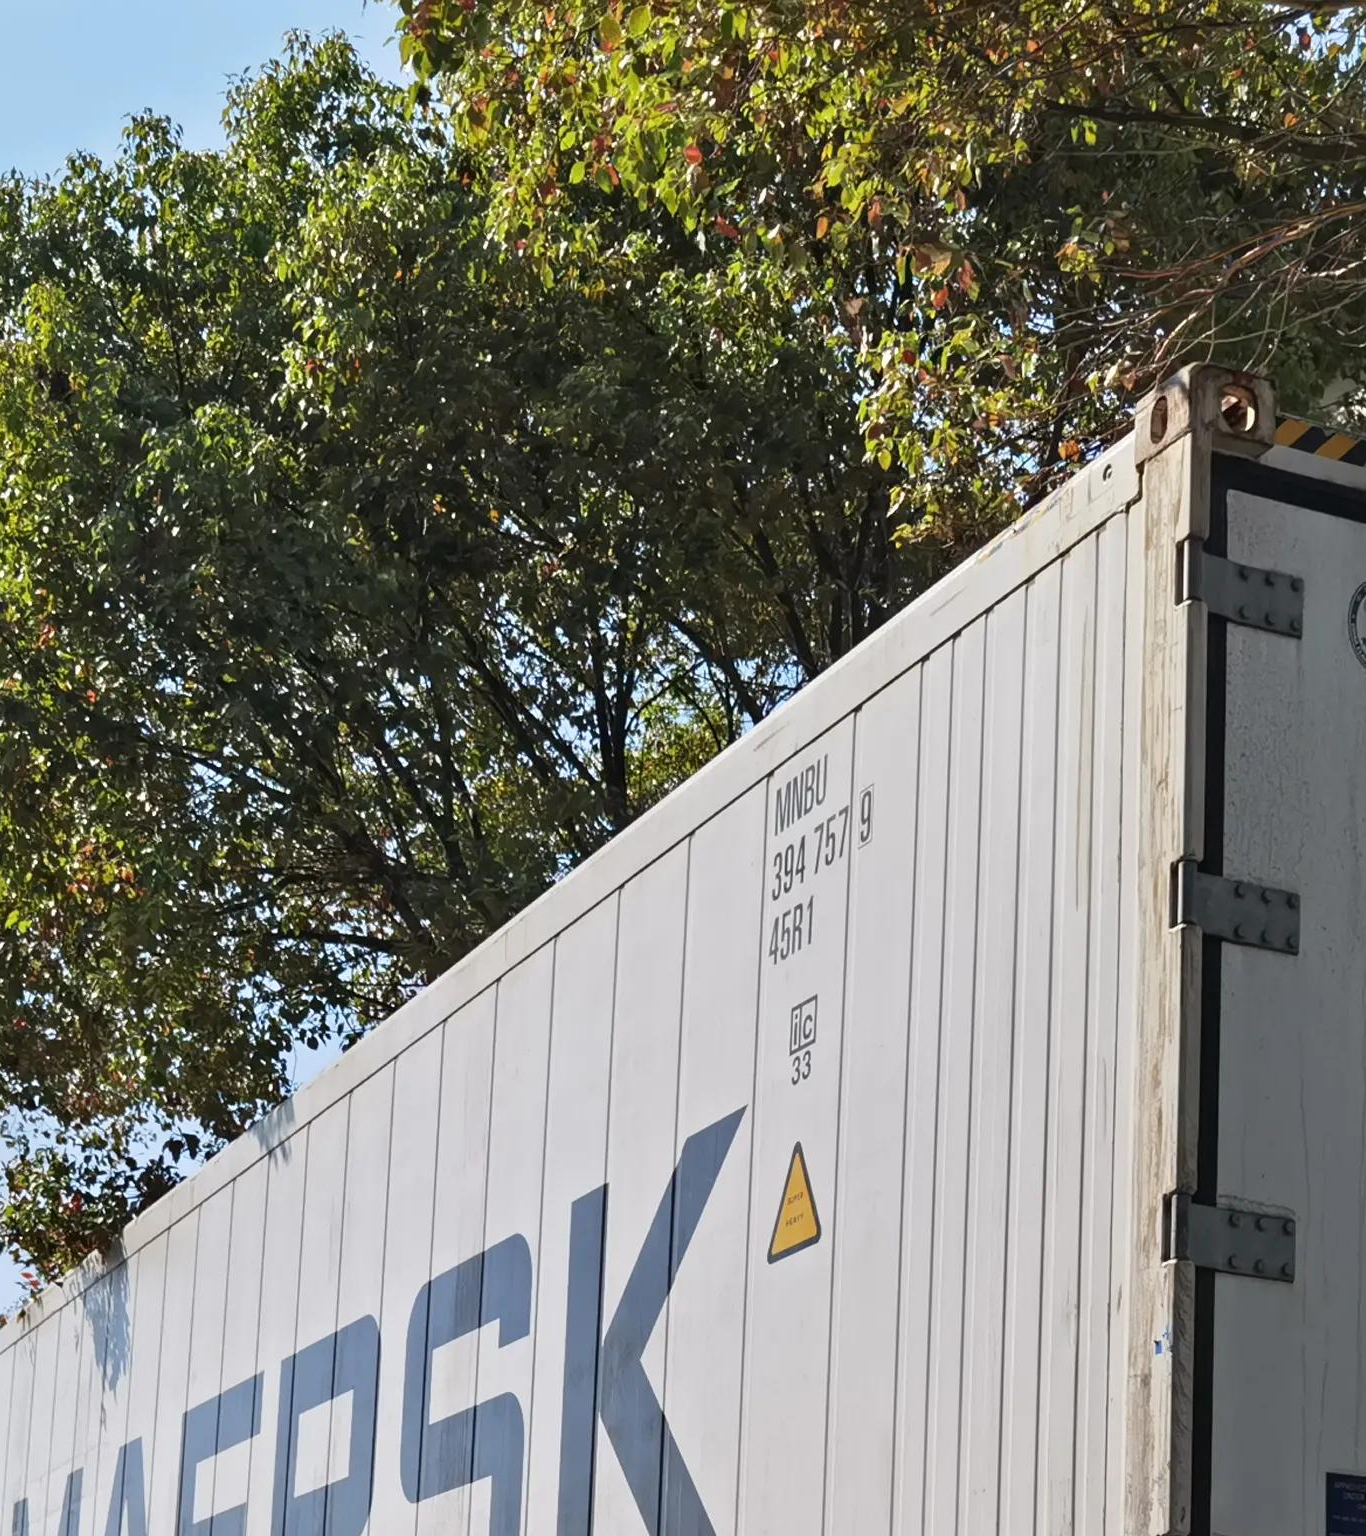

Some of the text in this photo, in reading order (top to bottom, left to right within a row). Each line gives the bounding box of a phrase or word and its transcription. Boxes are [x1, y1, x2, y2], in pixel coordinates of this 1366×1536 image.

[774, 753, 828, 837] MNBU
[772, 789, 872, 902] 394 757 9
[768, 895, 814, 966] 45R1
[791, 1052, 812, 1086] 33
